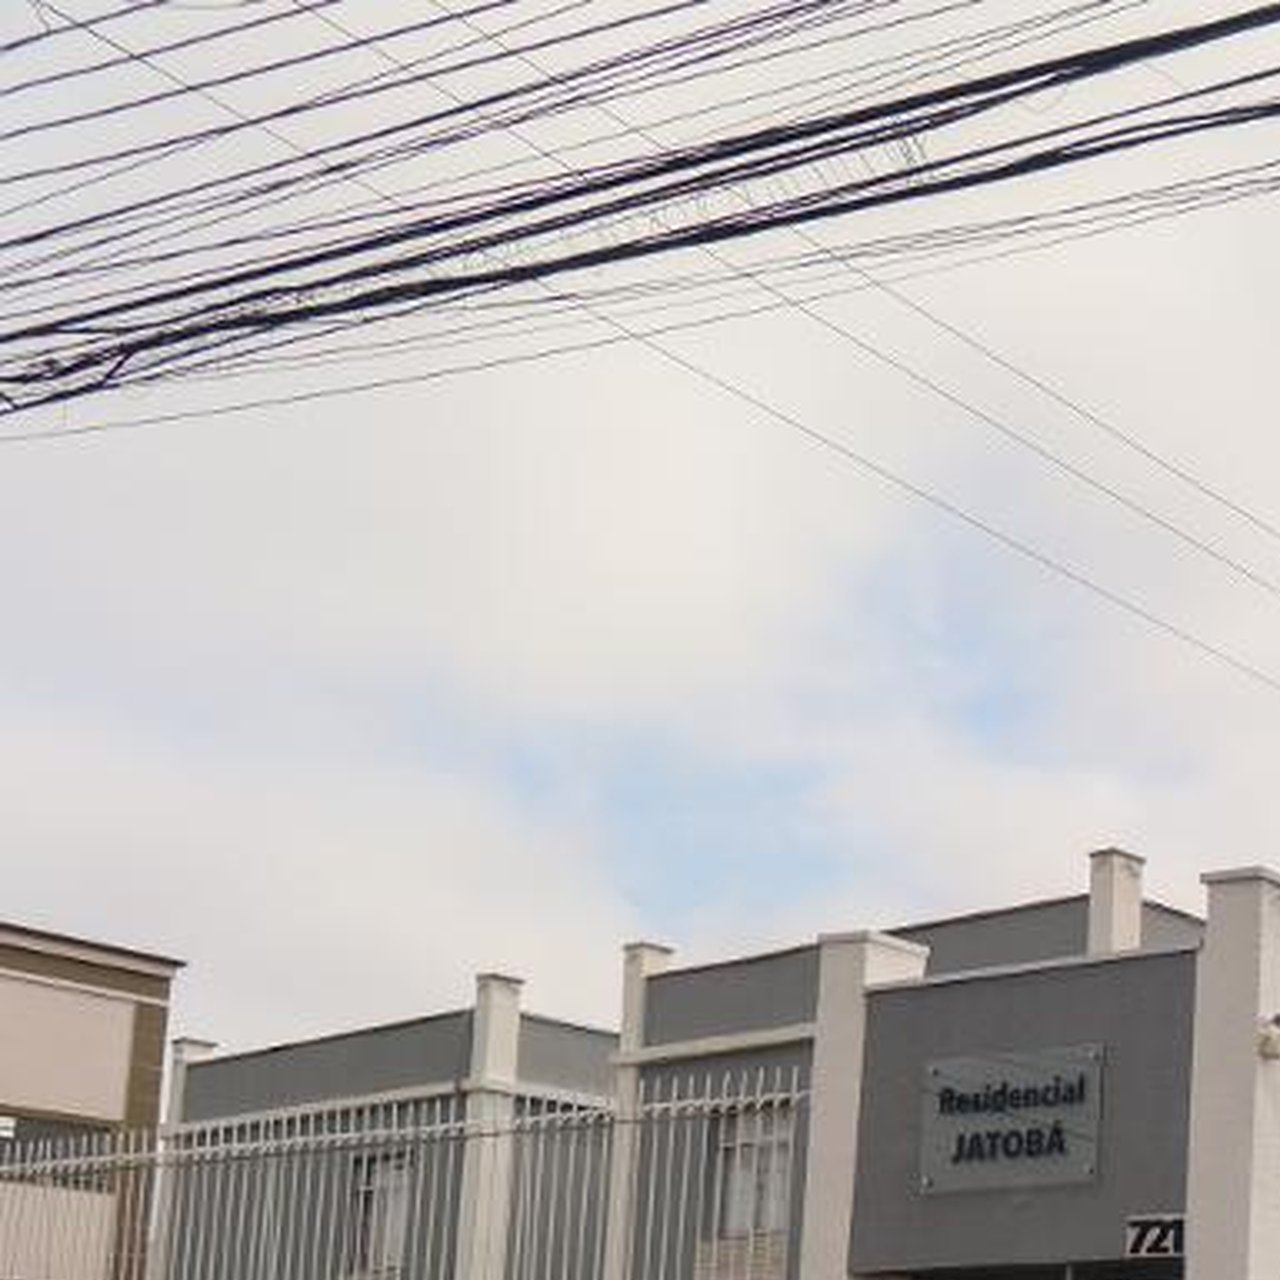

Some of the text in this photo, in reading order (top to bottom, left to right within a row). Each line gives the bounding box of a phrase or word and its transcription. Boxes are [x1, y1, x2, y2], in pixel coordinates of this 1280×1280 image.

[937, 1072, 1086, 1116] Residencial
[951, 1120, 1067, 1165] JATOBÁ
[1126, 1218, 1184, 1255] 721
